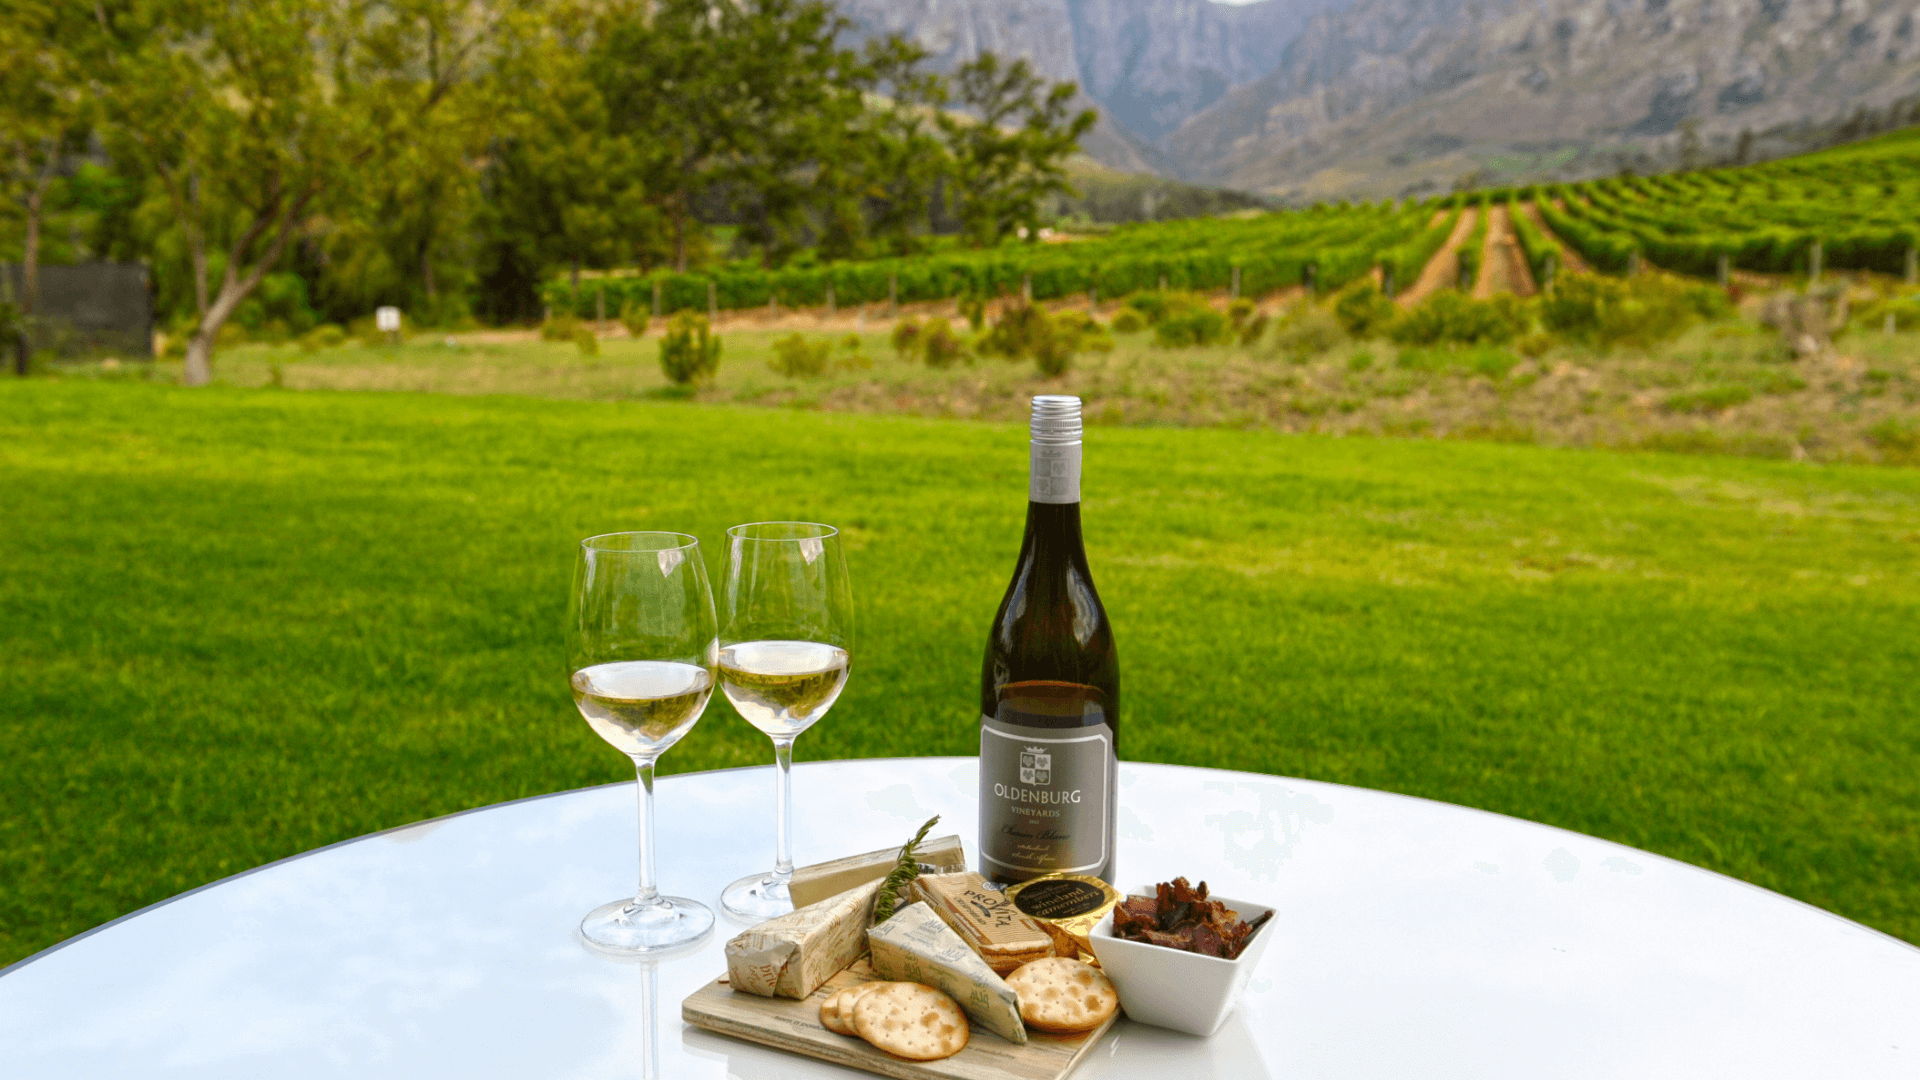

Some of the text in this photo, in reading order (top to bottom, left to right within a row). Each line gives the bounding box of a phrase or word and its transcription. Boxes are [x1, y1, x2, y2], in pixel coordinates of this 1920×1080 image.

[994, 783, 1081, 804] OLDENBURG
[1011, 806, 1060, 817] VINEYARDS
[1035, 891, 1100, 917] camembert
